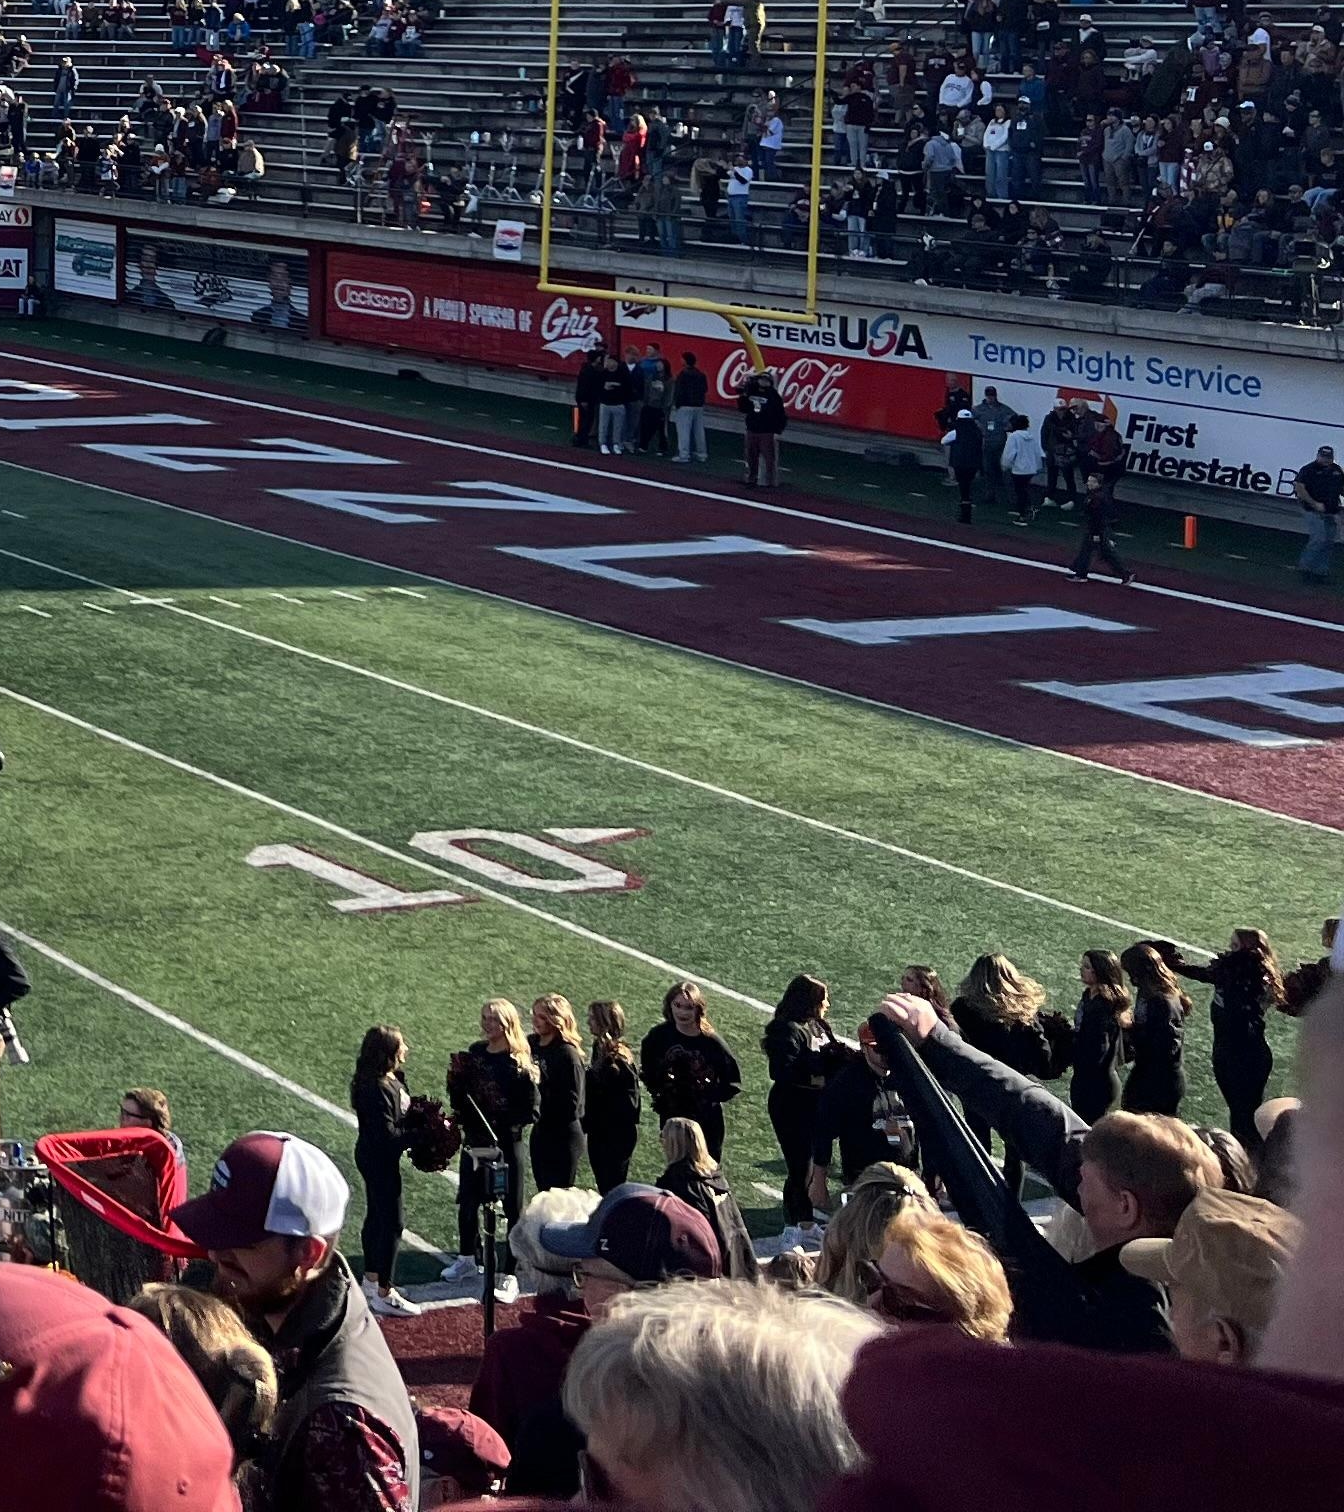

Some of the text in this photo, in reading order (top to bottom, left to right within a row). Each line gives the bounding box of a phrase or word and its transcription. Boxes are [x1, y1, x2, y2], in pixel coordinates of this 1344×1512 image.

[344, 286, 408, 311] Jacksons
[423, 296, 532, 332] A PROUD SPONSOR OF
[541, 297, 602, 352] Griz
[839, 312, 928, 359] USA
[968, 334, 1262, 397] Temp Right Service
[1125, 413, 1198, 448] First
[1122, 443, 1272, 492] Interstate
[244, 827, 645, 913] 10
